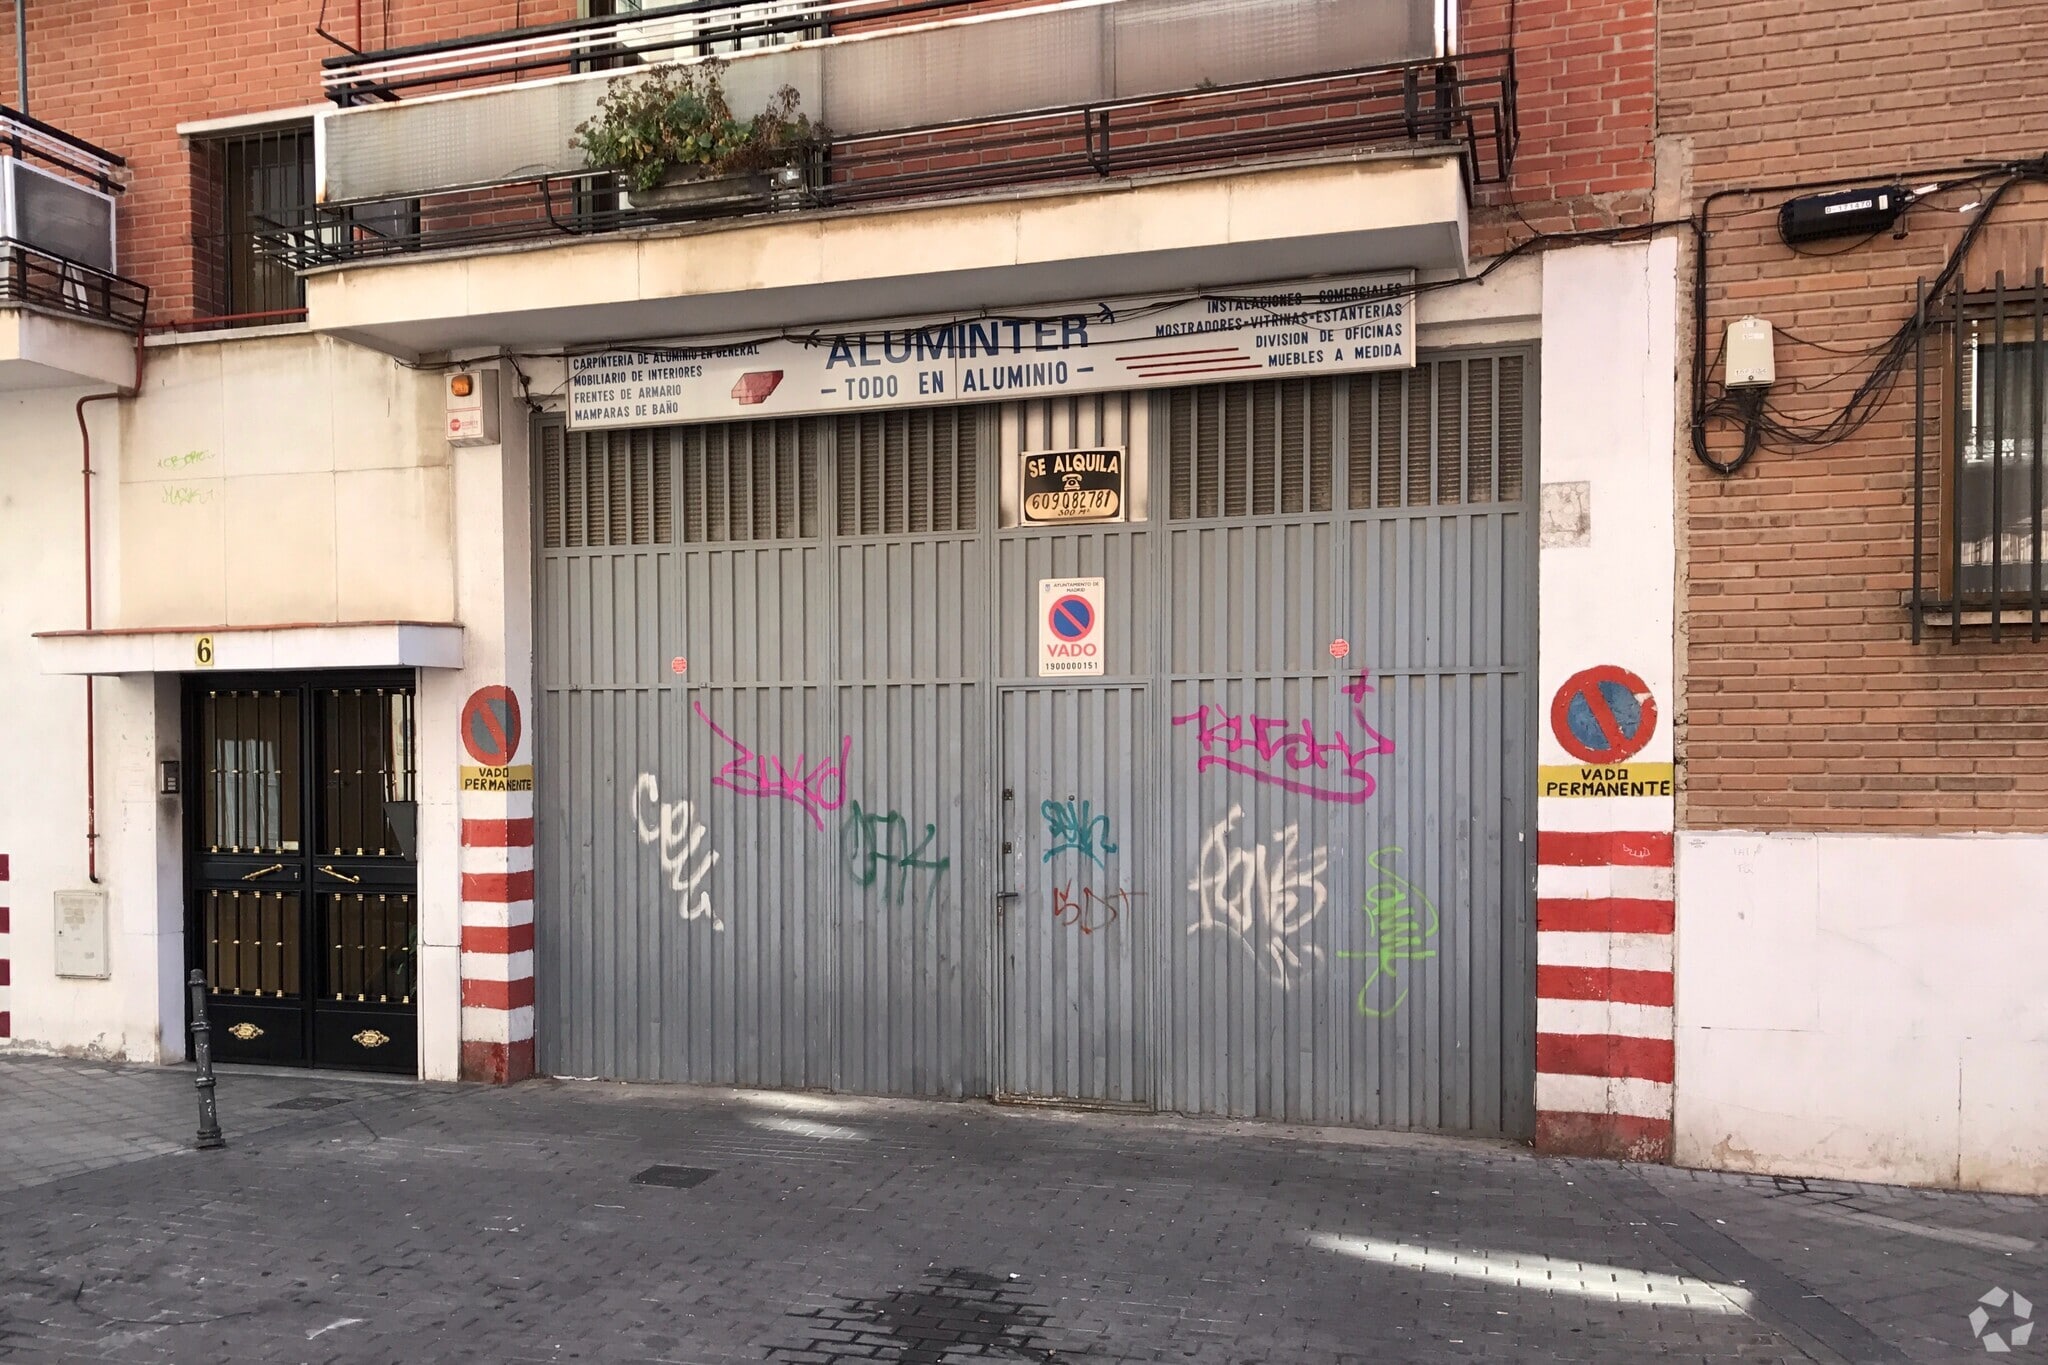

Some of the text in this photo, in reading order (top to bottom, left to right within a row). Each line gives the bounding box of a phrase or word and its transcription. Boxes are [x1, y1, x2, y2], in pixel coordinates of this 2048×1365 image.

[1207, 283, 1402, 314] INSTALACIONES COMERCIALES
[825, 314, 1089, 370] ALUMINTER
[1256, 323, 1402, 348] DIVISION DE OFICINAS
[573, 345, 760, 370] CARPINTERIA DE ALUMINIO EN GENERAL
[1268, 343, 1402, 367] MUEBLES A MEDIDA
[574, 365, 703, 387] MOBILIARIO DE INTERIORES
[845, 361, 1068, 401] TODO EN ALUMINIO
[574, 384, 682, 404] FRENTES DE ARMARIO
[575, 400, 678, 421] MAMPARAS DE BAÑO
[1028, 453, 1119, 478] SE ALQUILA
[197, 637, 211, 663] 6
[1046, 643, 1097, 657] VADO
[479, 767, 509, 778] VADO
[1581, 768, 1628, 781] VADO
[464, 779, 532, 792] PERMANENTE
[1546, 780, 1671, 797] PERMANENTE
